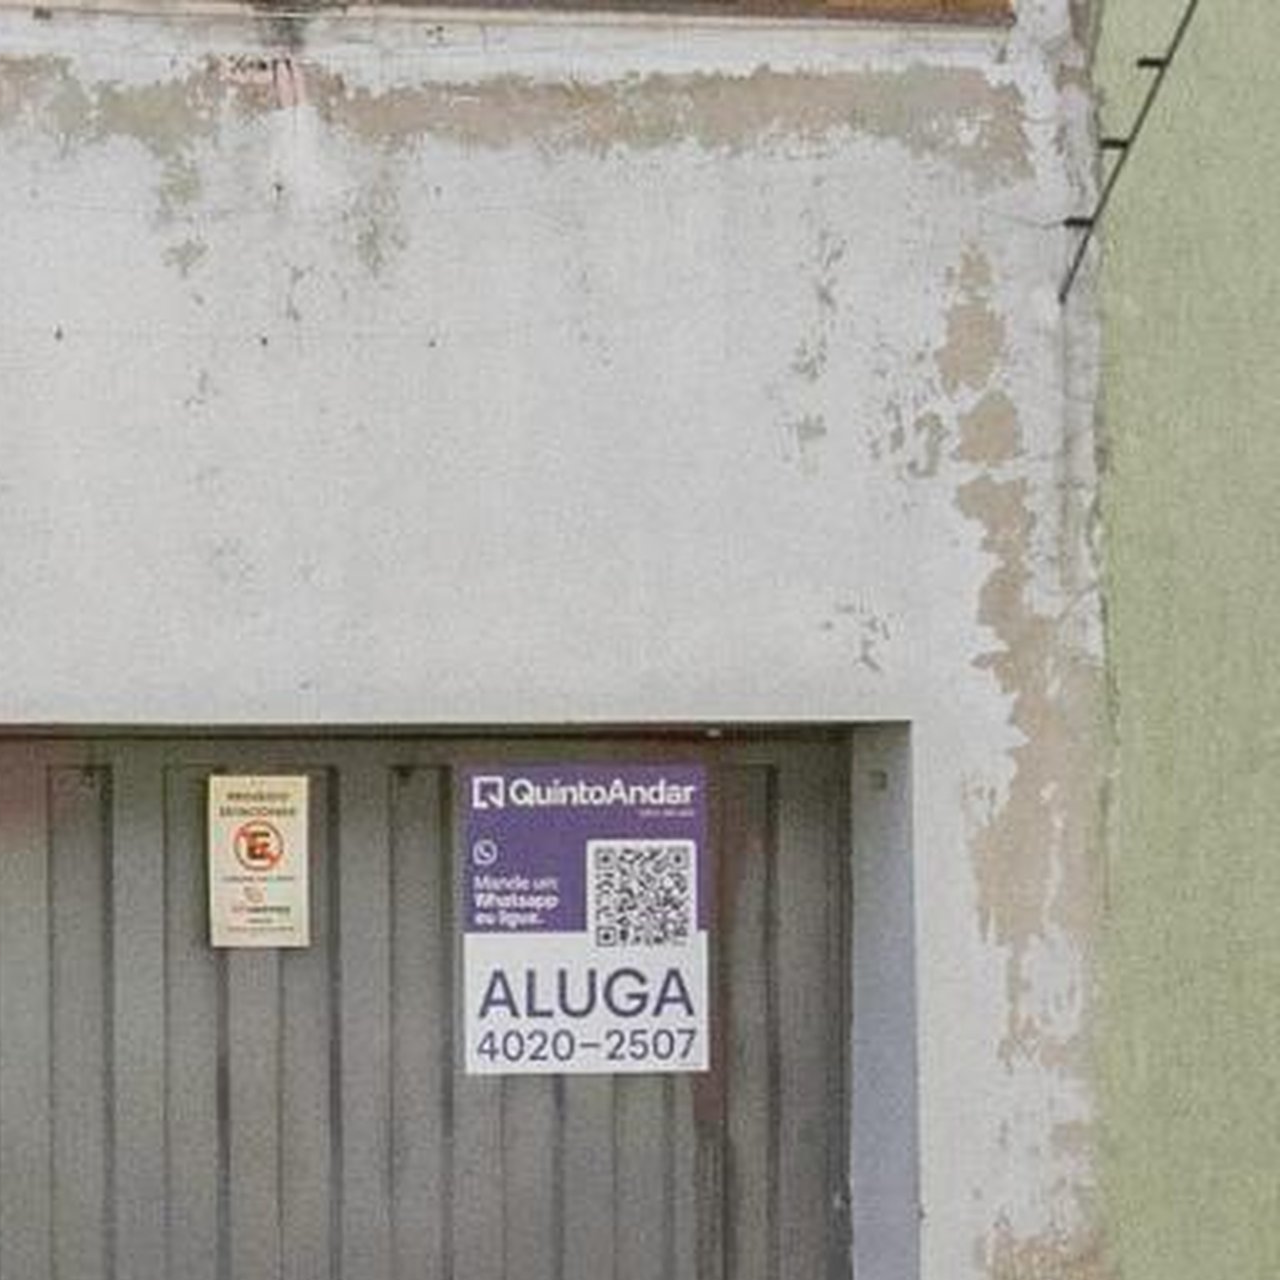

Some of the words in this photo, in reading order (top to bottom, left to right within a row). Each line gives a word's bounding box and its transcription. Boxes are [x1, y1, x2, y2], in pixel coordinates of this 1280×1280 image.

[508, 778, 695, 806] QuintoAndar
[478, 967, 695, 1019] ALUGA
[476, 1028, 697, 1062] 4020-2507
